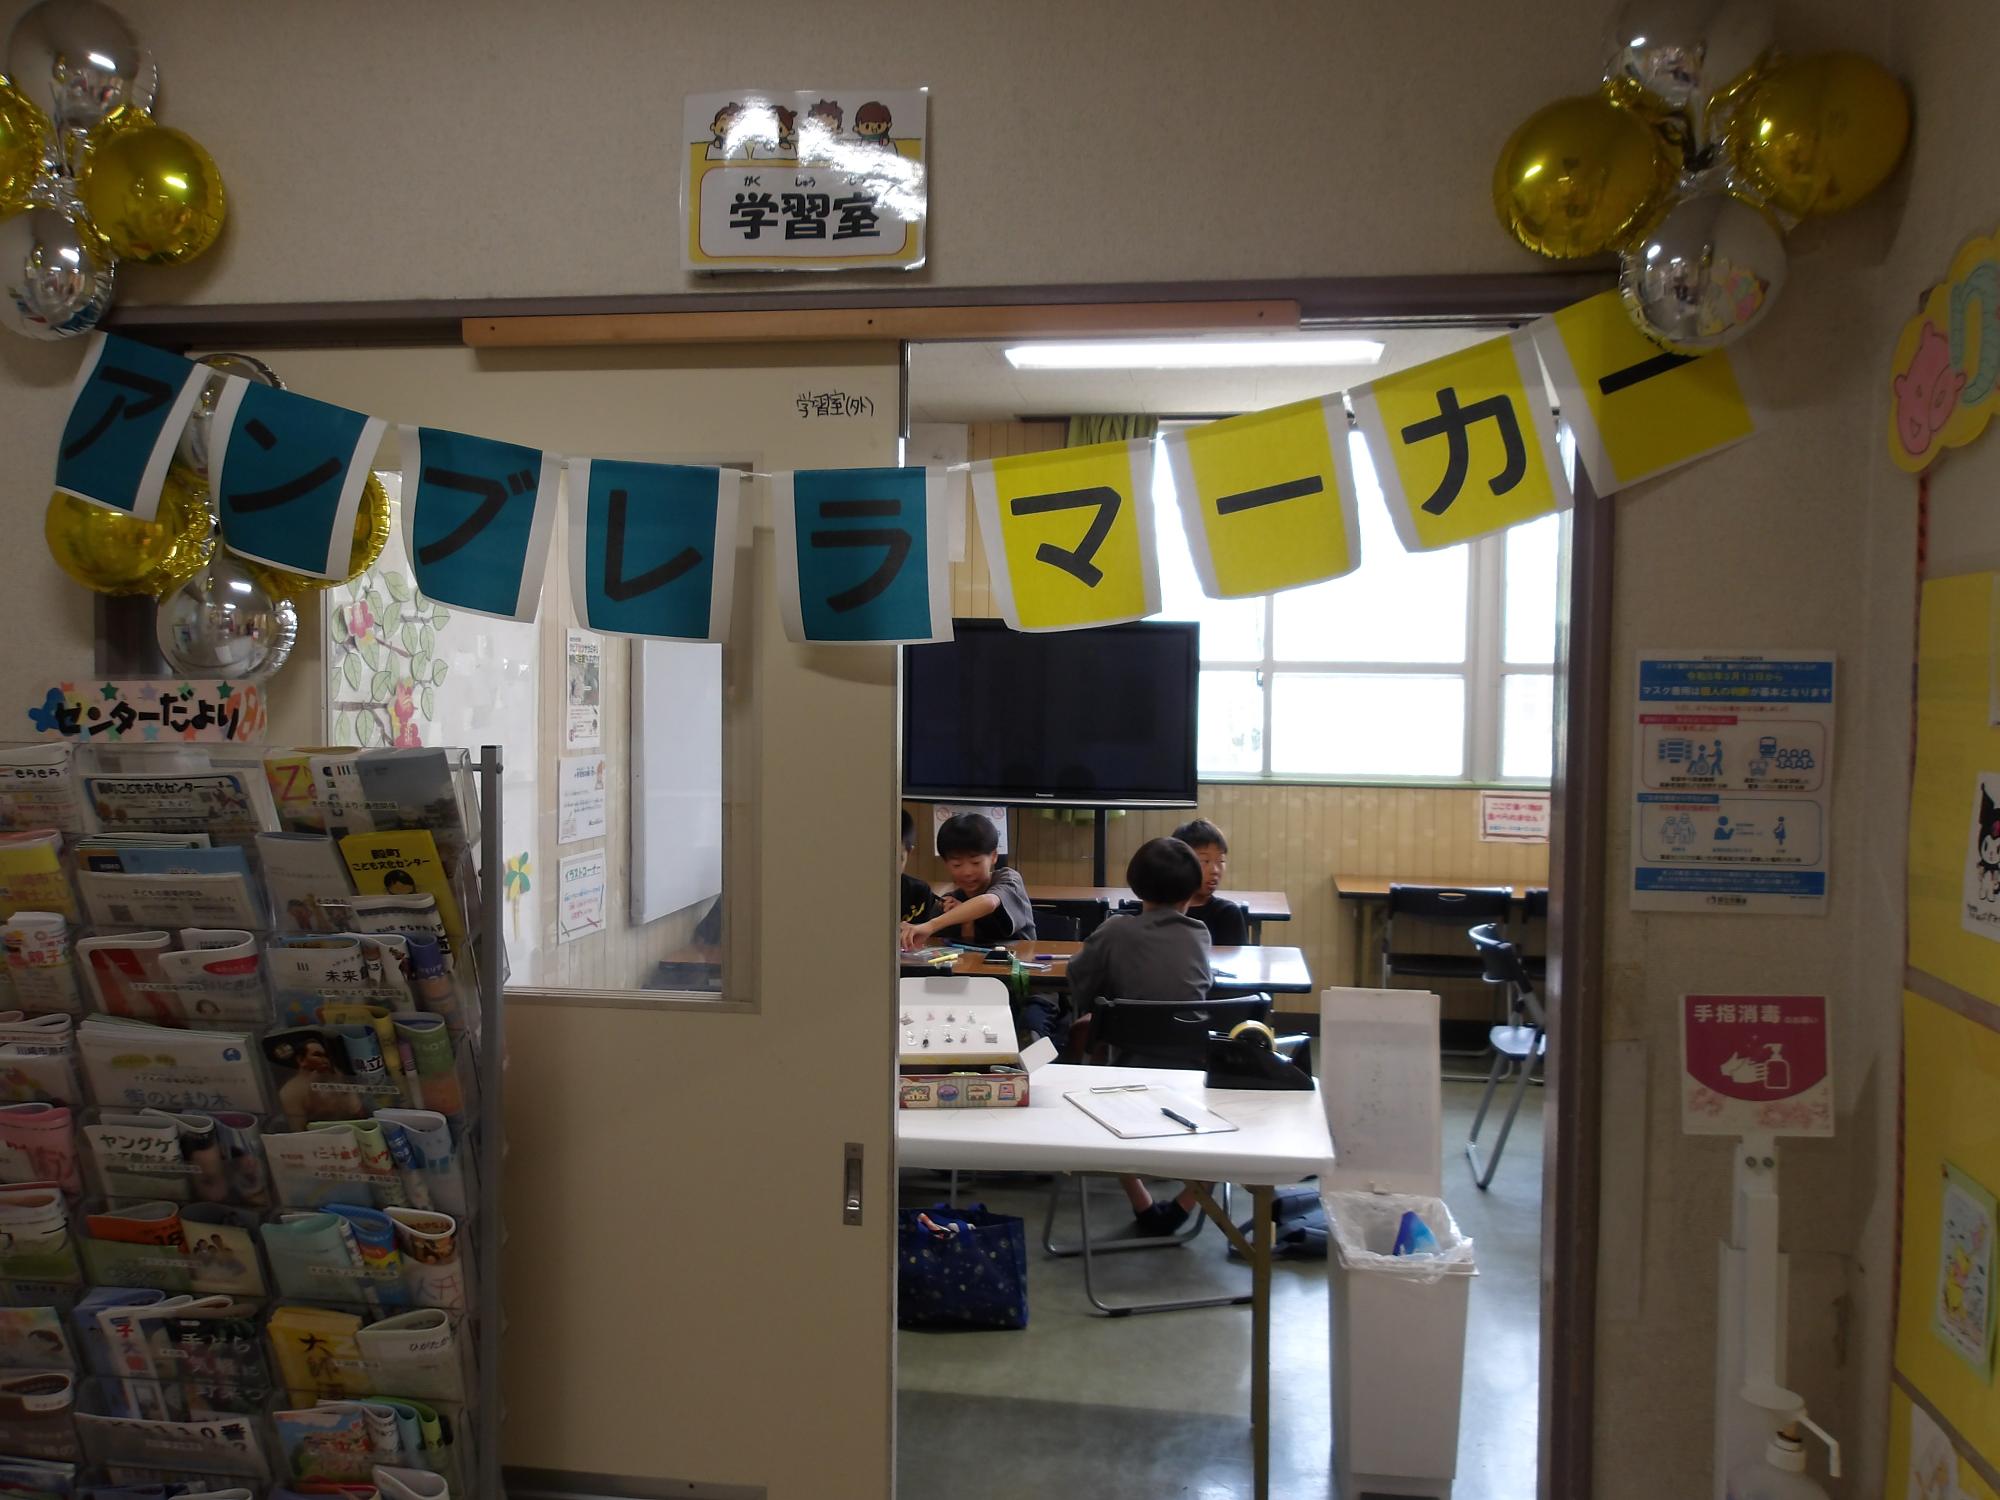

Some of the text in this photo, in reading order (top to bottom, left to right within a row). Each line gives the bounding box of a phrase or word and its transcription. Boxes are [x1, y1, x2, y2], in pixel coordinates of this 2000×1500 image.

[744, 176, 761, 187] がく
[795, 176, 816, 187] しゅう
[730, 192, 881, 240] 学習室
[796, 391, 875, 417] 学習室(外)
[1694, 1004, 1780, 1023] 手指消毒
